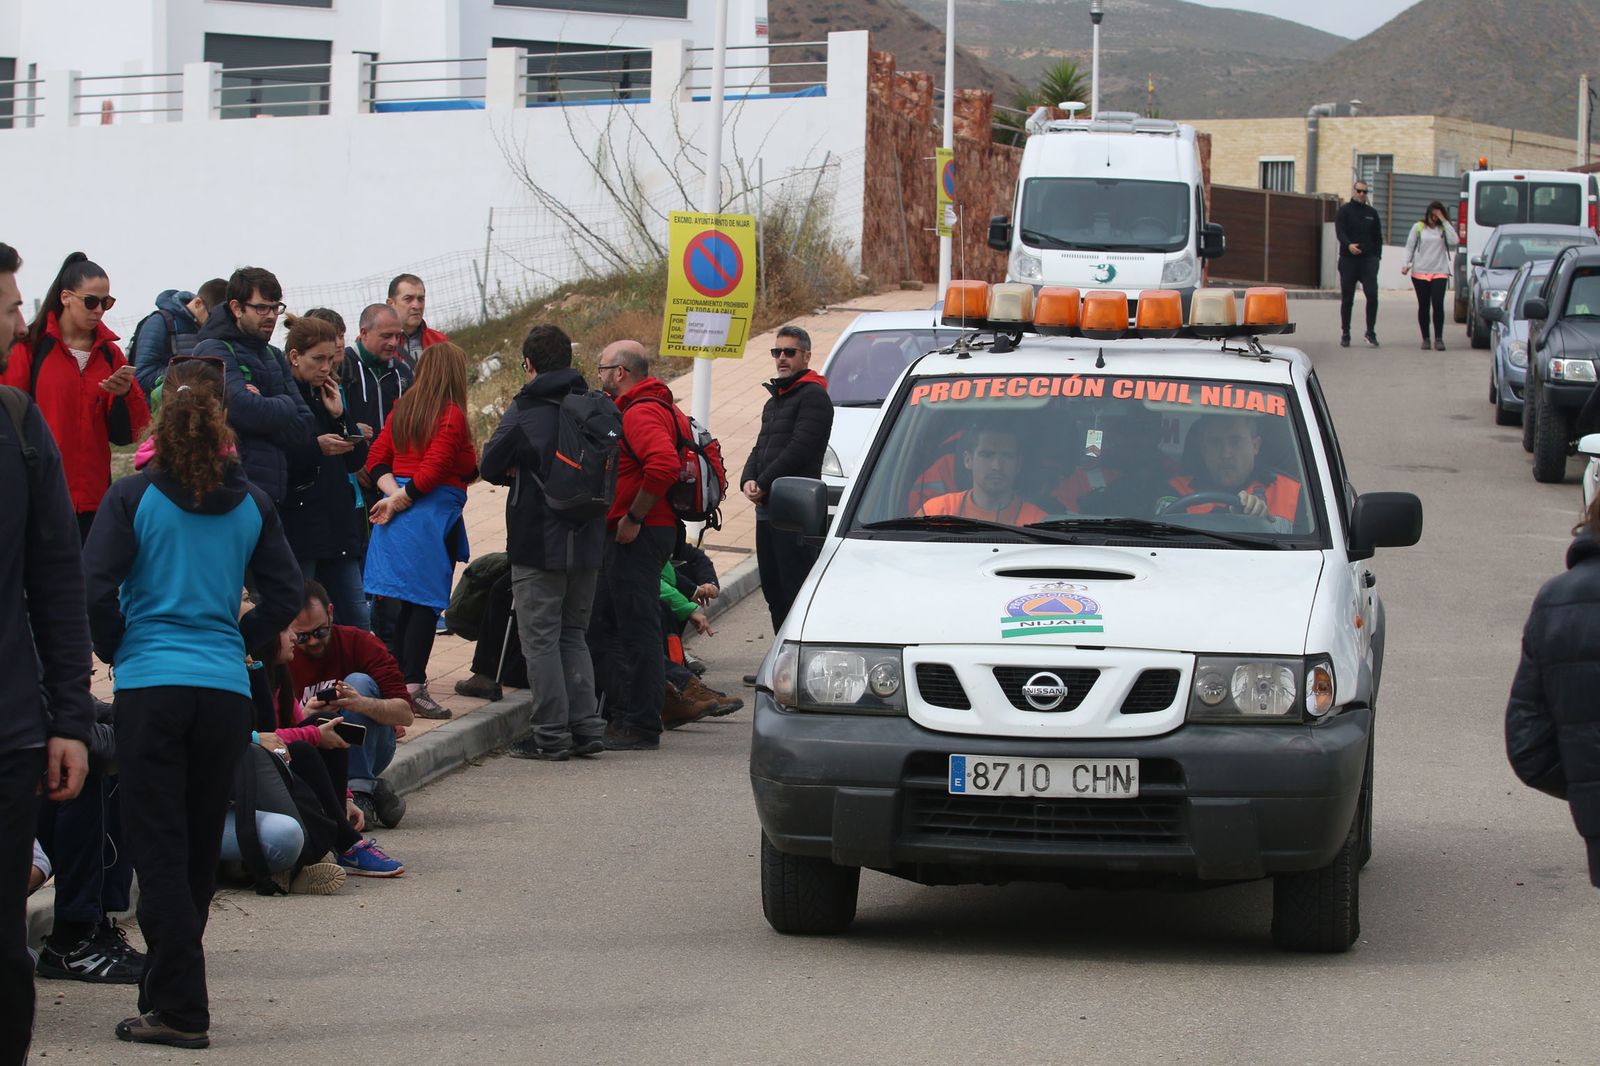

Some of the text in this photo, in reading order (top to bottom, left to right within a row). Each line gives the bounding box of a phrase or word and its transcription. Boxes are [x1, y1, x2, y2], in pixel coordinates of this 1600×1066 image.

[672, 298, 722, 307] ESTACIONAMIENTO
[712, 346, 738, 354] OCAL
[911, 374, 1286, 417] PROTECCIÓN CIVIL NÍJAR
[1020, 619, 1086, 627] NIJAR
[1026, 687, 1063, 695] NISSAN
[972, 762, 1131, 793] 8710 CHN
[954, 778, 962, 787] E
